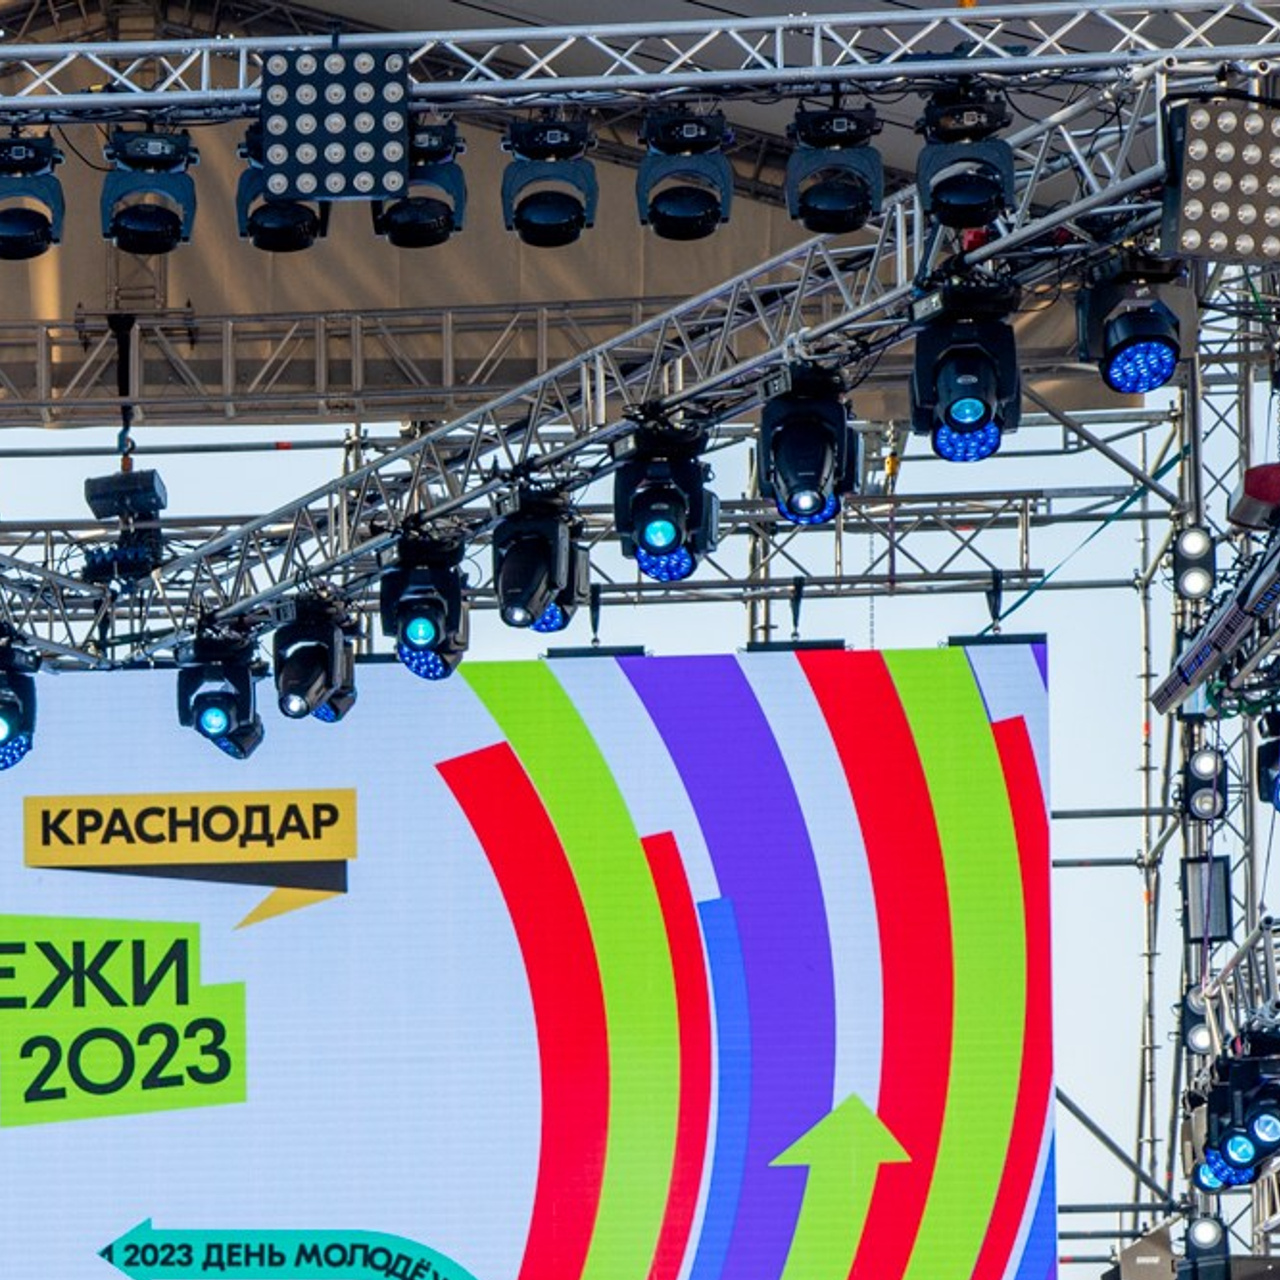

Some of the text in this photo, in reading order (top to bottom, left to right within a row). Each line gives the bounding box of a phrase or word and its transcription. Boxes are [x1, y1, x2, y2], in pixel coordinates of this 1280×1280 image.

[40, 803, 340, 849] КРАСНОДАР
[19, 1017, 232, 1104] 2023
[123, 1242, 194, 1267] 2023
[202, 1242, 286, 1271] ДЕНЬ
